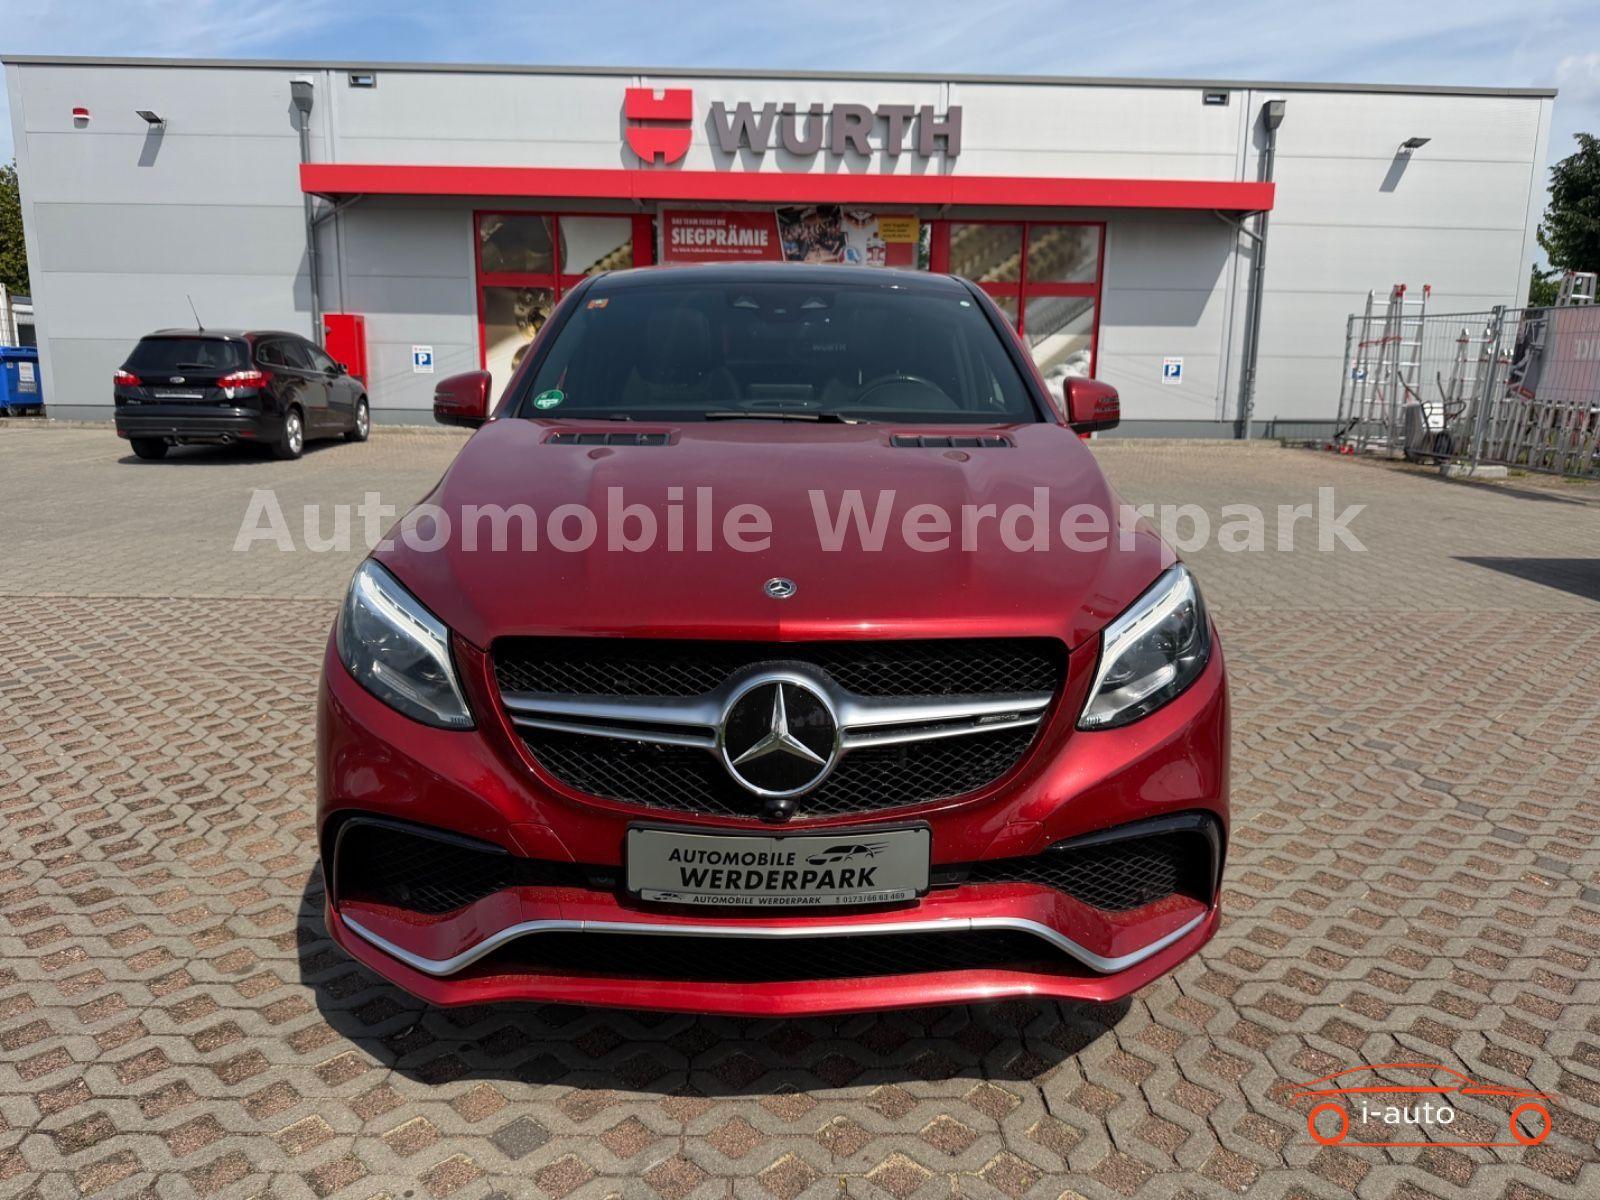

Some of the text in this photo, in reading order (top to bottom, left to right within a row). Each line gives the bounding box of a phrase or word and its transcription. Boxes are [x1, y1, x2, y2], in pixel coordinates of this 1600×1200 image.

[671, 224, 768, 247] SIEGPRÄMIE
[418, 353, 428, 366] P
[1168, 364, 1178, 377] P
[668, 848, 796, 866] AUTOMOBILE
[679, 866, 878, 890] WERDERPARK
[692, 896, 754, 905] AUTOMOBILE
[758, 896, 822, 905] WERDERPARK
